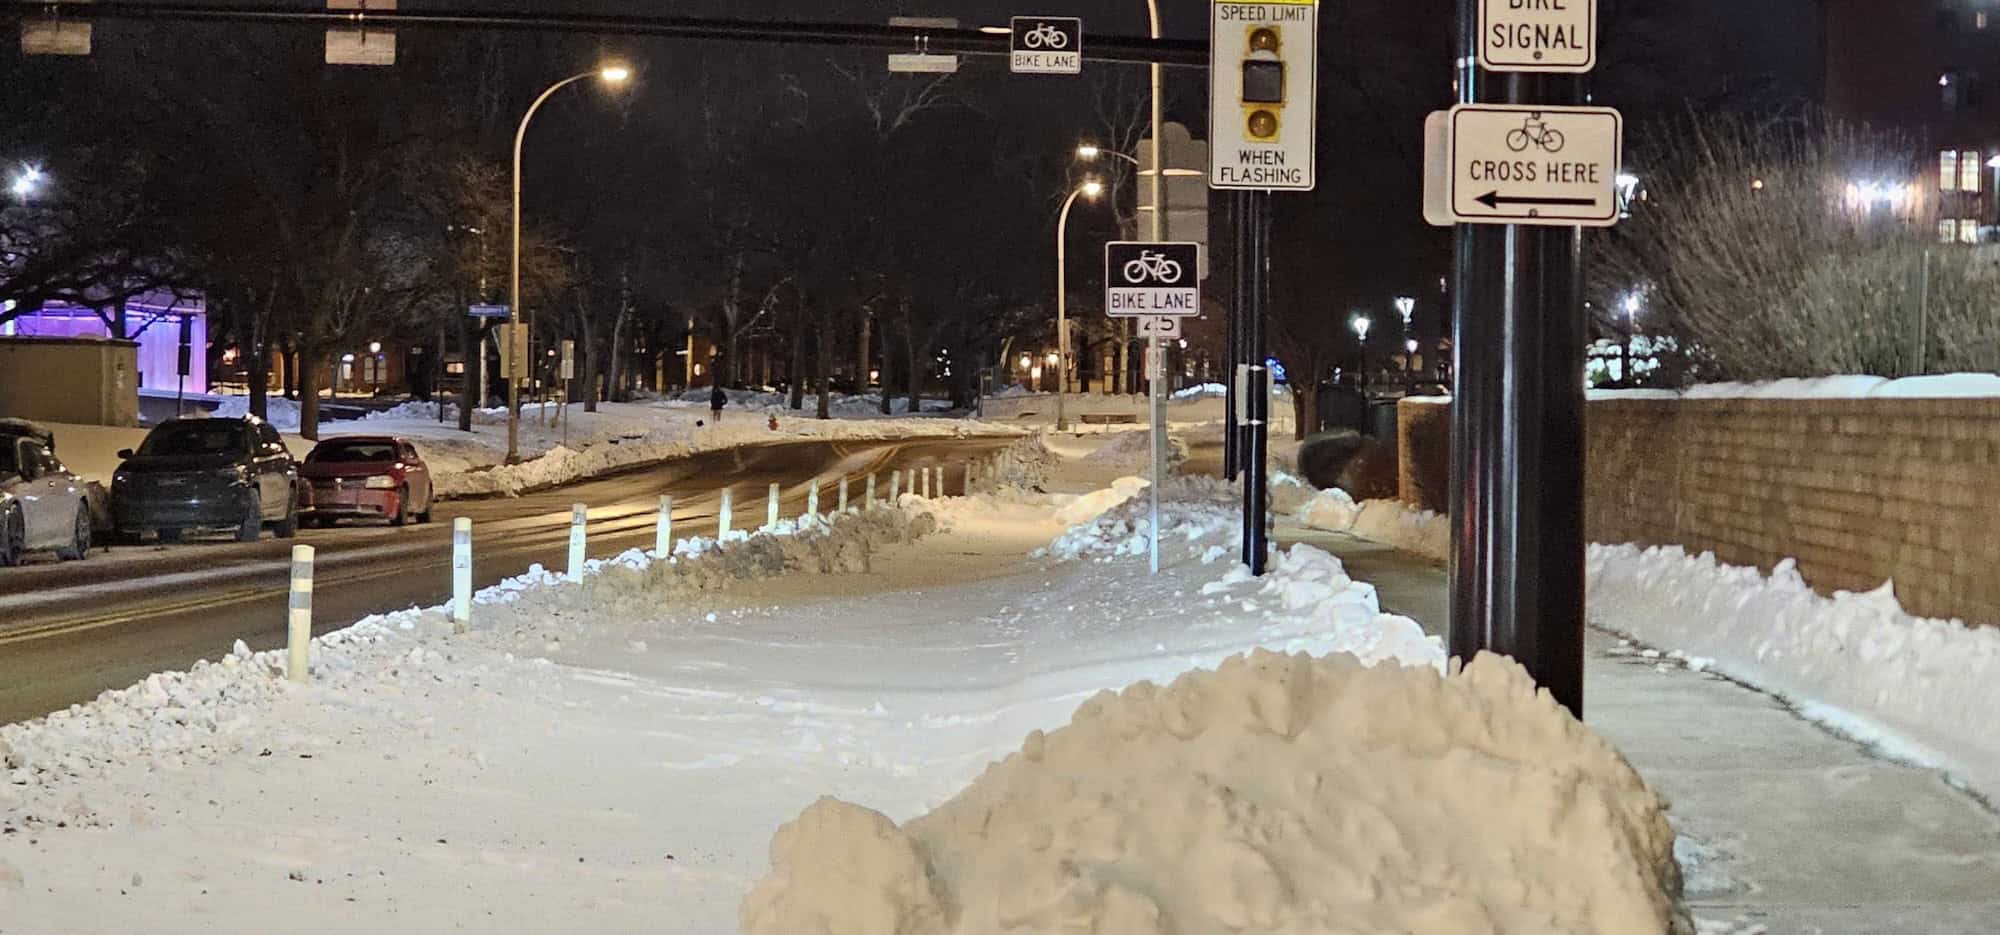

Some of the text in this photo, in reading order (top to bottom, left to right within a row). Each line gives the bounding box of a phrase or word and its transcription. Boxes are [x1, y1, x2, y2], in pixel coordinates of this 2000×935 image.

[1220, 5, 1308, 21] SPEED LIMIT
[1491, 23, 1583, 49] SIGNAL
[1015, 54, 1076, 68] BIKE LANE
[1239, 150, 1285, 166] WHEN
[1220, 167, 1301, 184] FLASHING
[1470, 159, 1600, 184] CROSS HERE
[1111, 292, 1194, 309] BIKE LANE
